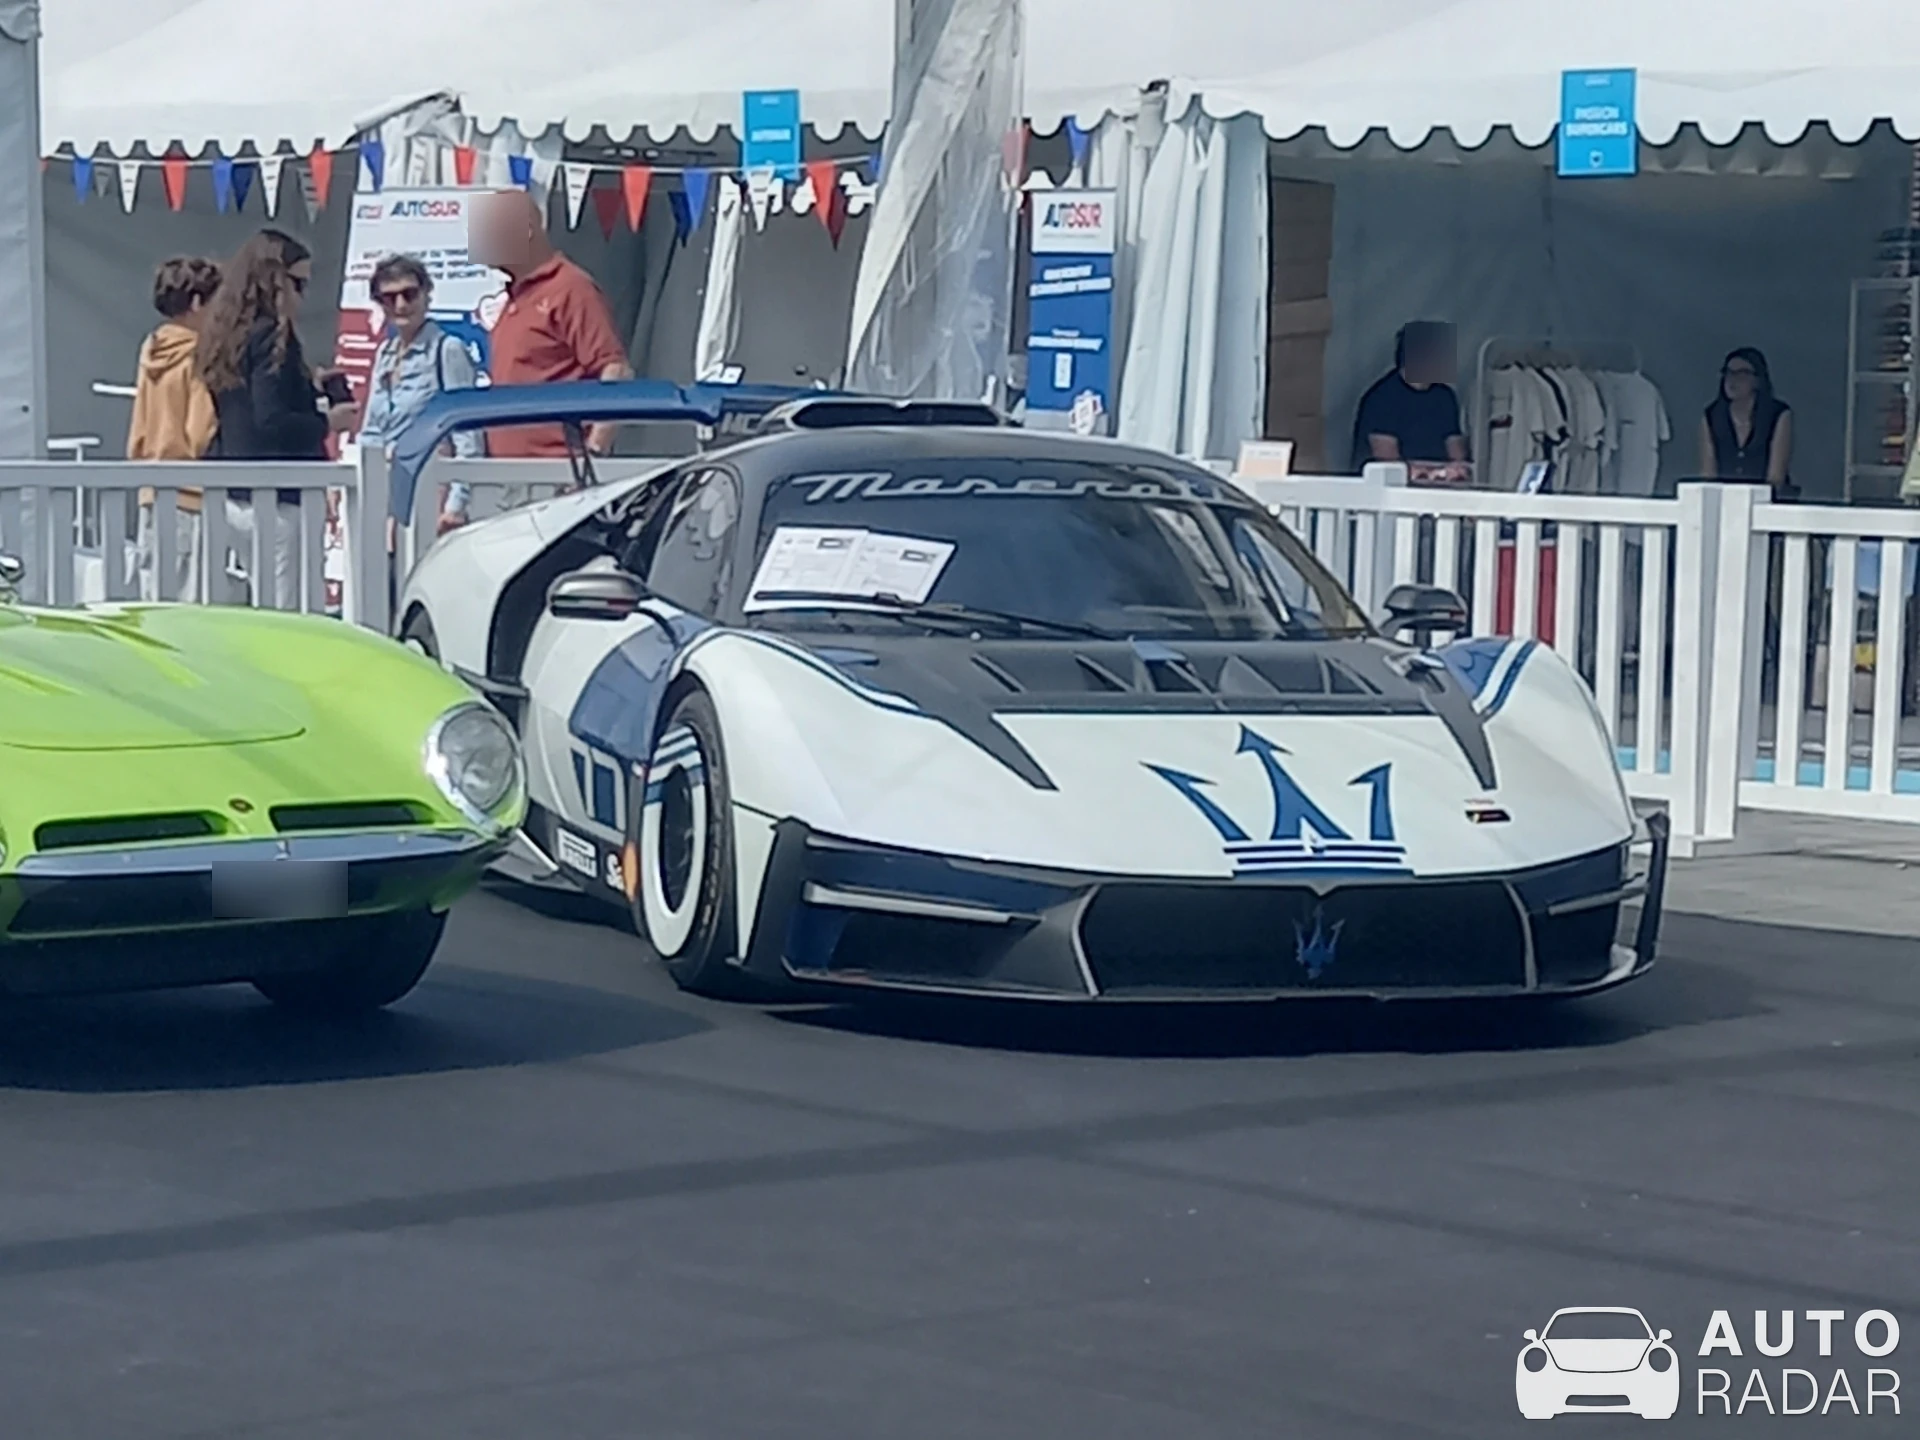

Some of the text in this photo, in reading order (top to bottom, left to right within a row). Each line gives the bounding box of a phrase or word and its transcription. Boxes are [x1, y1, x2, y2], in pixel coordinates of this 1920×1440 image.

[390, 200, 461, 217] AUTOSUR
[1042, 202, 1101, 228] AUTOSUR
[791, 472, 1252, 509] Maserati
